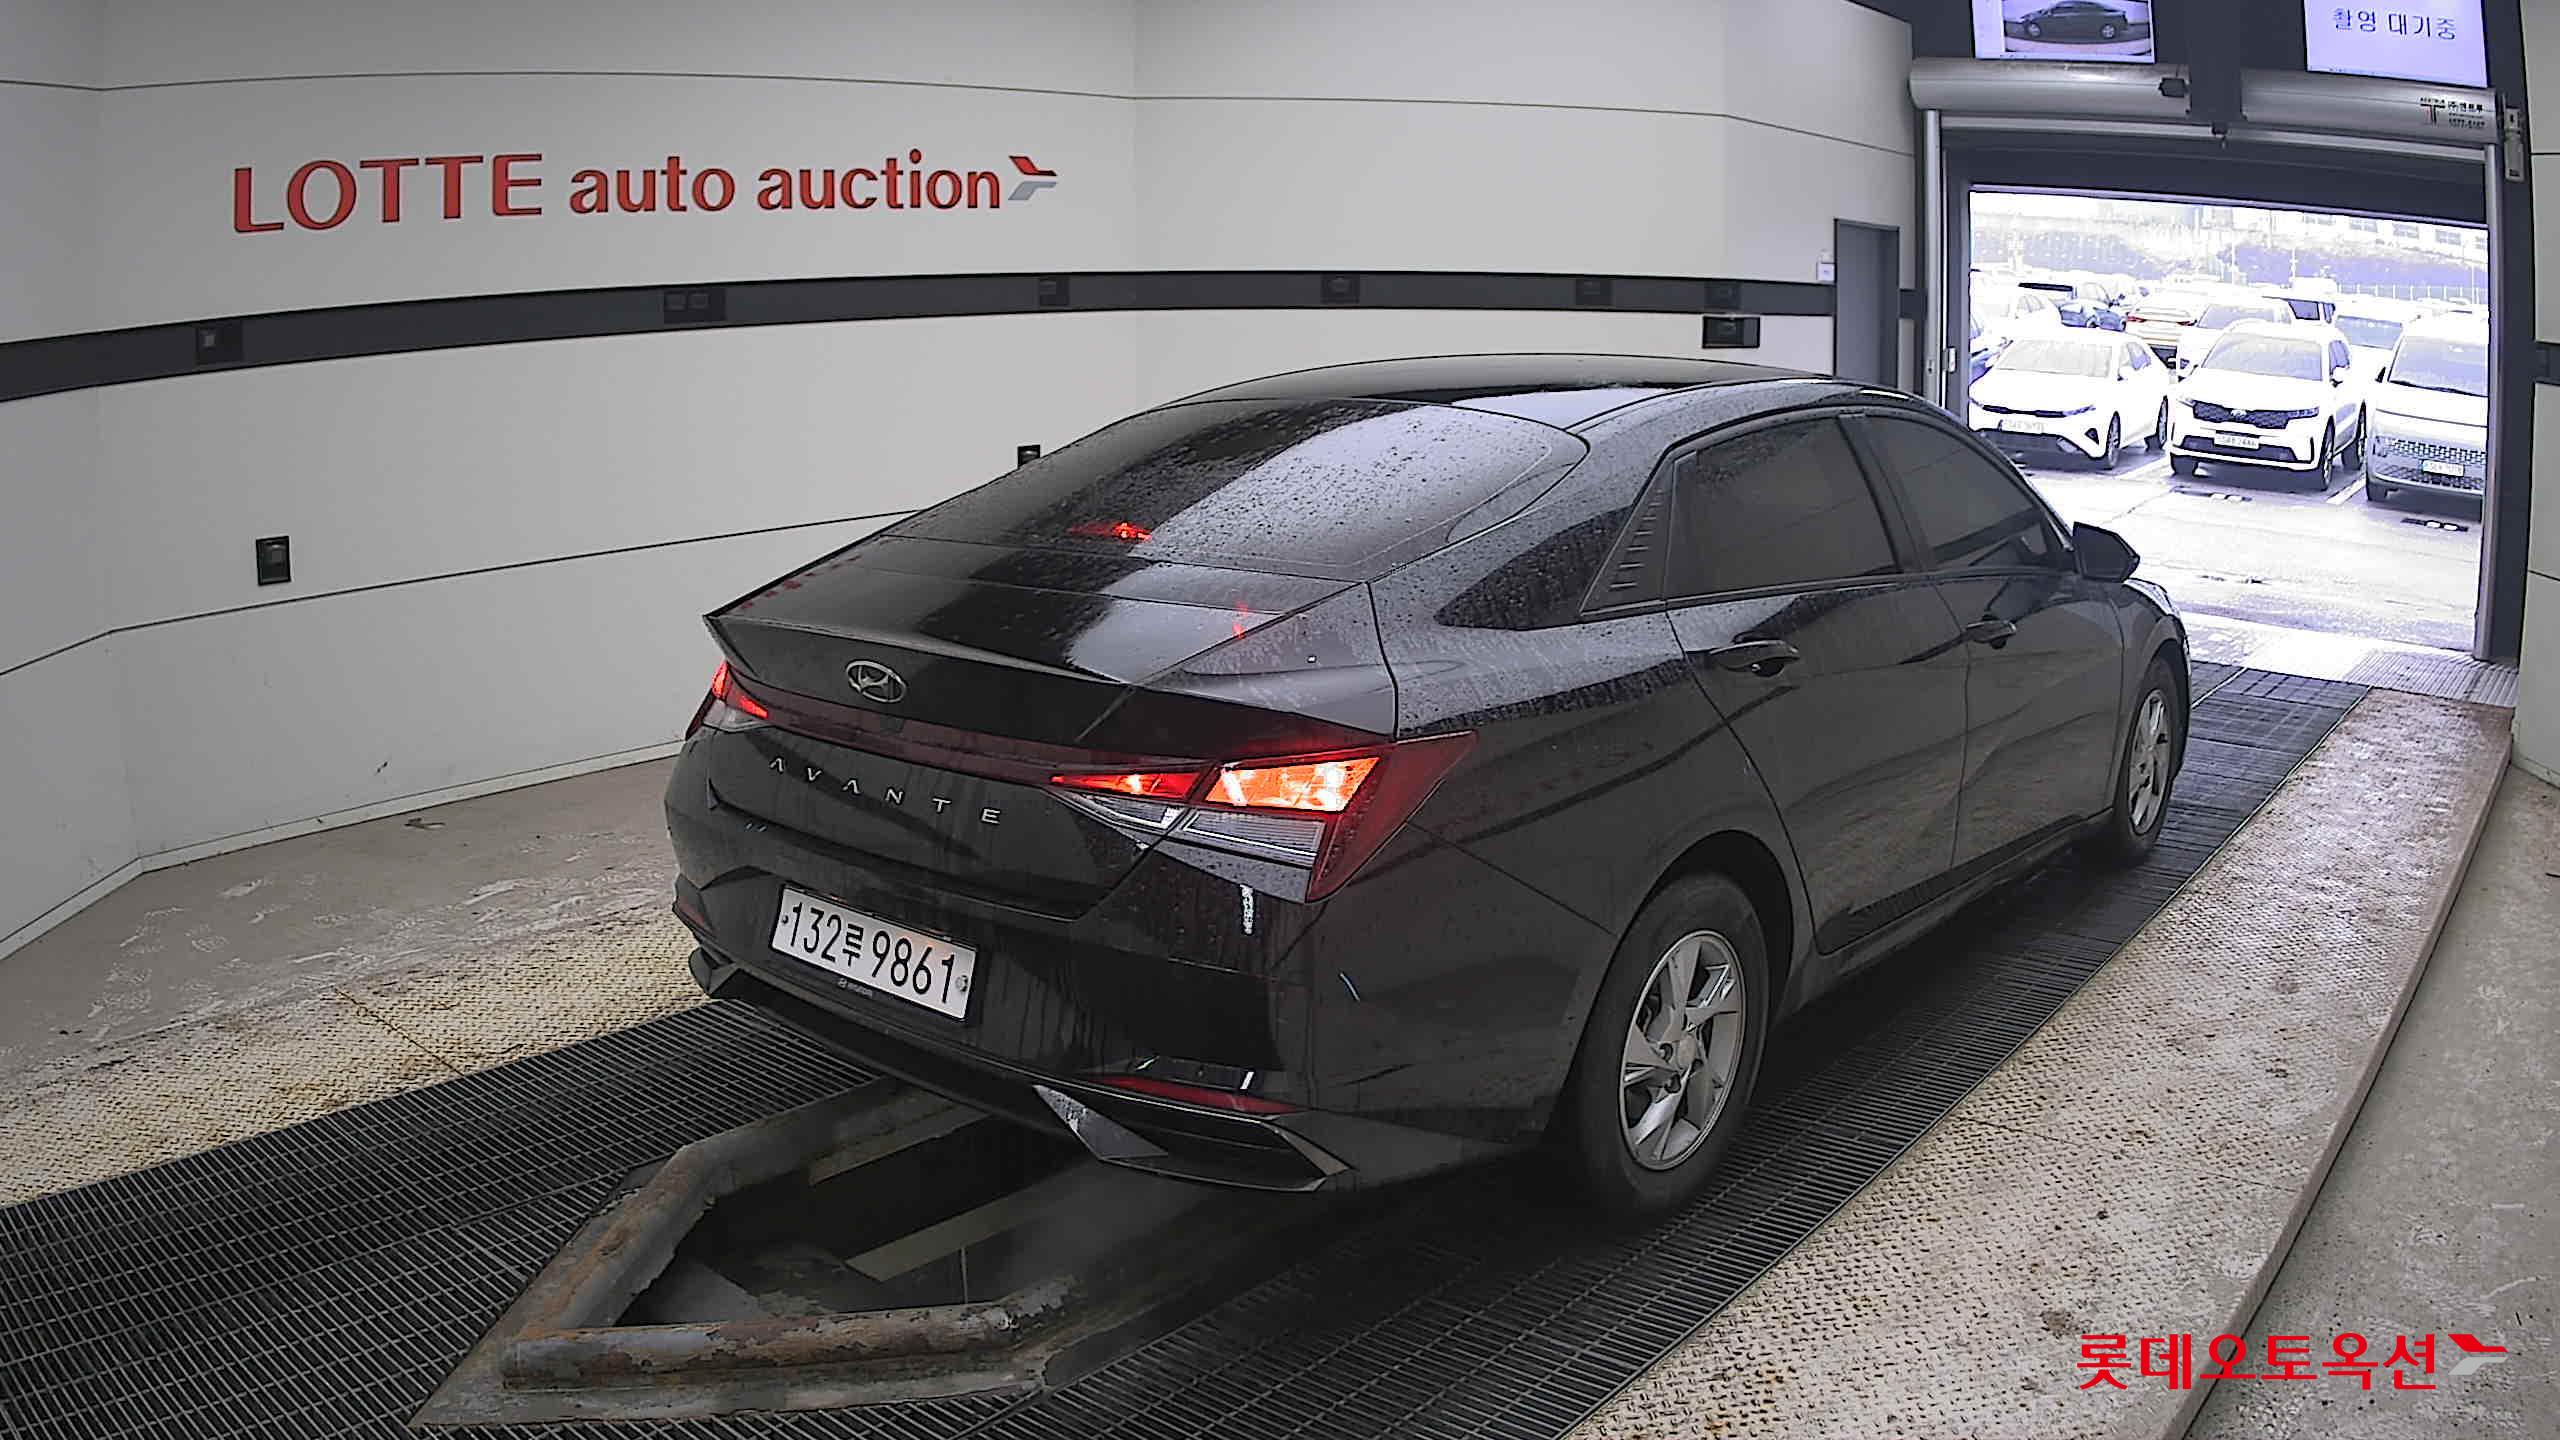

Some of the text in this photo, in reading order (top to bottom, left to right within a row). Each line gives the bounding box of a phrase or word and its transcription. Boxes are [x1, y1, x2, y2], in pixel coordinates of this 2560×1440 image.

[2389, 14, 2456, 40] 대기중
[234, 149, 1000, 233] LOTTE auto auction
[770, 758, 1001, 824] AVANTE
